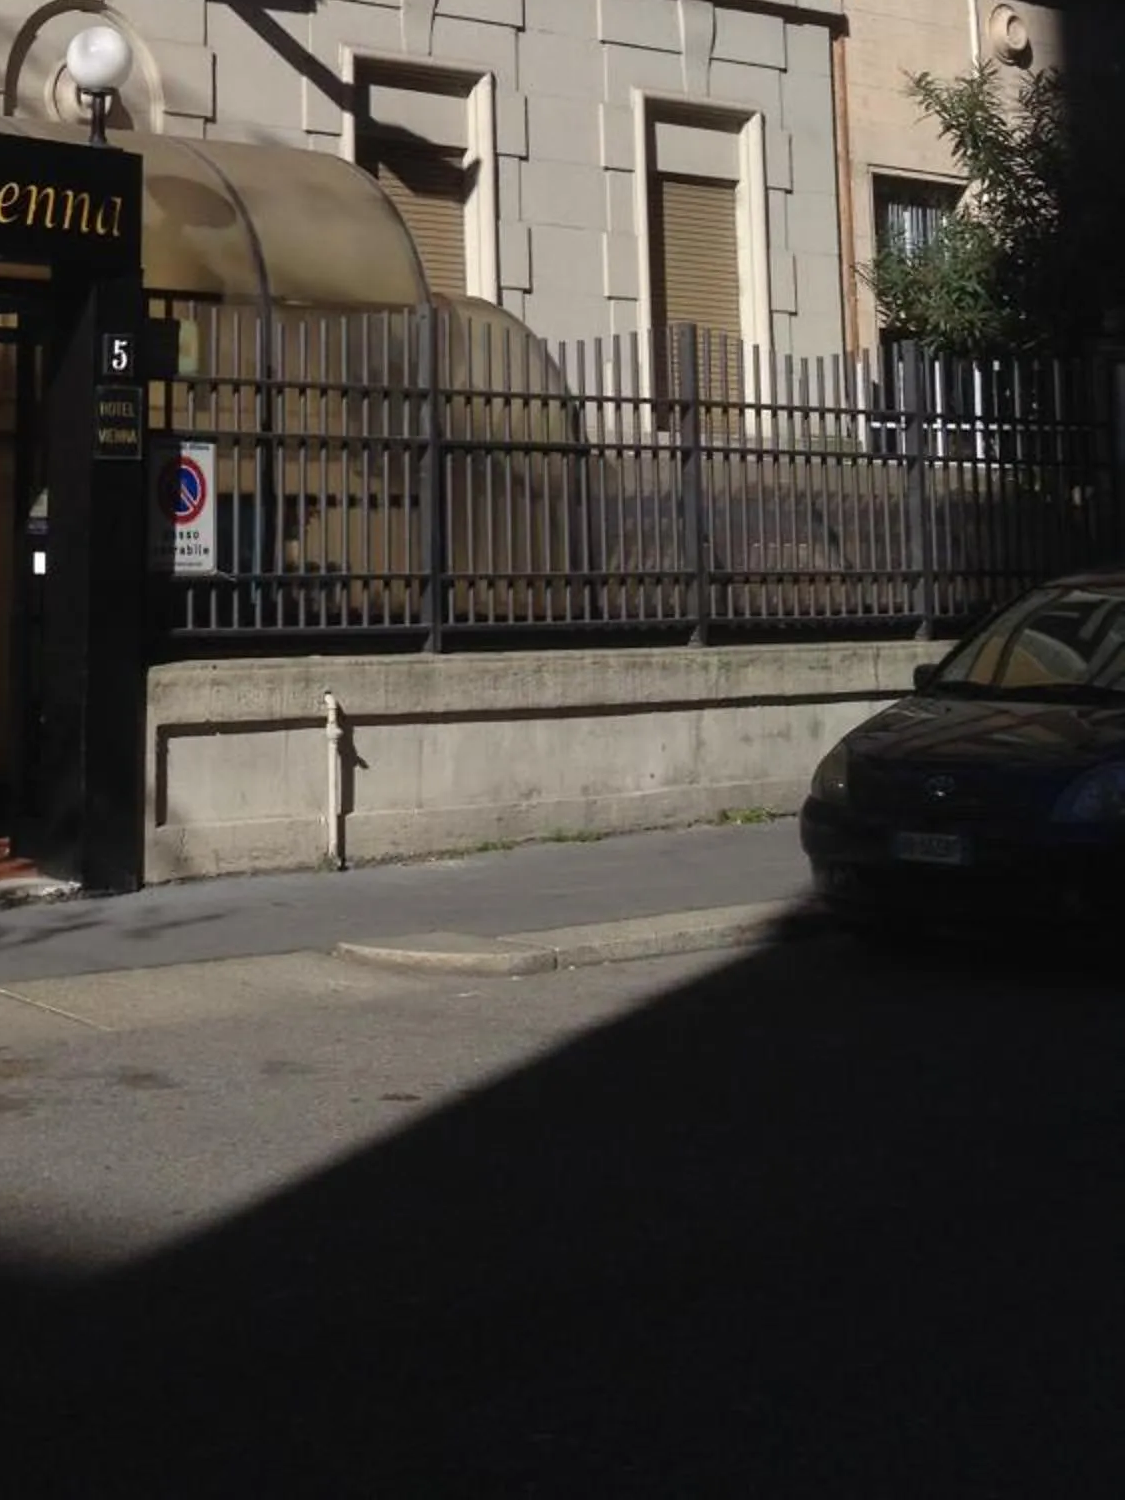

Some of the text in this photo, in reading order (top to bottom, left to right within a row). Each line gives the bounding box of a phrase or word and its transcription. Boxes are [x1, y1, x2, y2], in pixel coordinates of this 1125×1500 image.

[111, 339, 128, 370] 5
[99, 401, 136, 417] HOTEL
[98, 428, 137, 444] VIENNA
